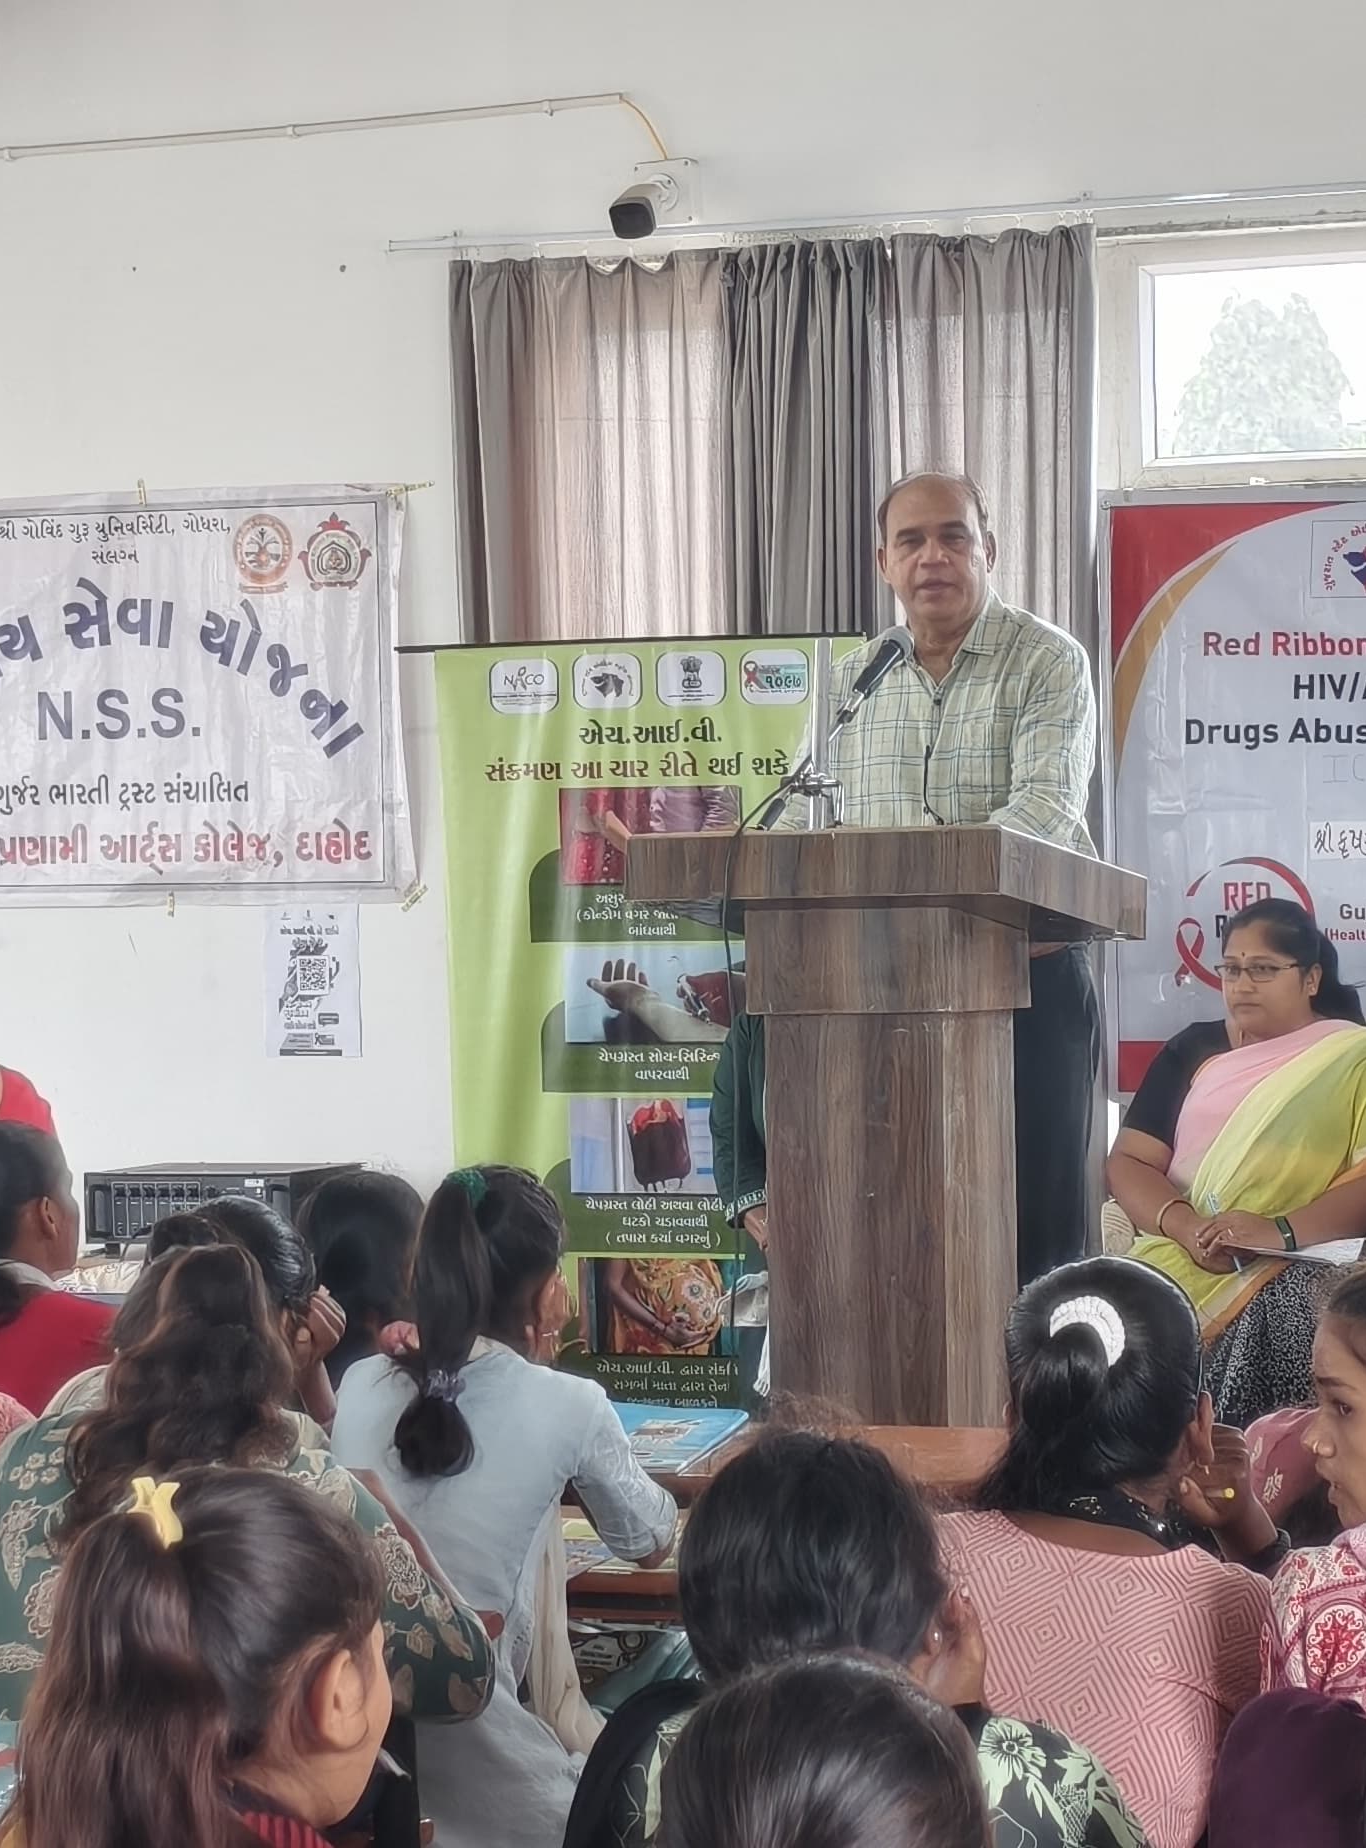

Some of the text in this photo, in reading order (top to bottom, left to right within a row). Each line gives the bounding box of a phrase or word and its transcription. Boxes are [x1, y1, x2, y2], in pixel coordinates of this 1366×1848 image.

[21, 518, 63, 540] ગોવિંદ
[182, 512, 231, 536] ગોધરા,
[91, 545, 140, 564] સંલગ્ન
[1203, 631, 1261, 657] Red
[62, 577, 174, 650] સેવા
[199, 598, 364, 760] યોજના
[37, 687, 201, 741] N.S.S.
[578, 716, 723, 746] એચ.આઈ.વી.
[1185, 718, 1280, 751] Drugs
[485, 749, 790, 782] સંક્રમણ આ ચાર રીતે થઈ શકે
[48, 774, 110, 806] ભારતી
[118, 782, 157, 812] ટ્રસ્ટ
[163, 771, 250, 805] સંચાલિત
[99, 821, 182, 876] આર્ટ્સ
[193, 819, 284, 868] કોલેજ,
[295, 817, 373, 865] દાહોદ
[634, 1066, 690, 1081] વાપરવાથી
[631, 1196, 657, 1211] લોહી
[660, 1200, 694, 1211] અથવા
